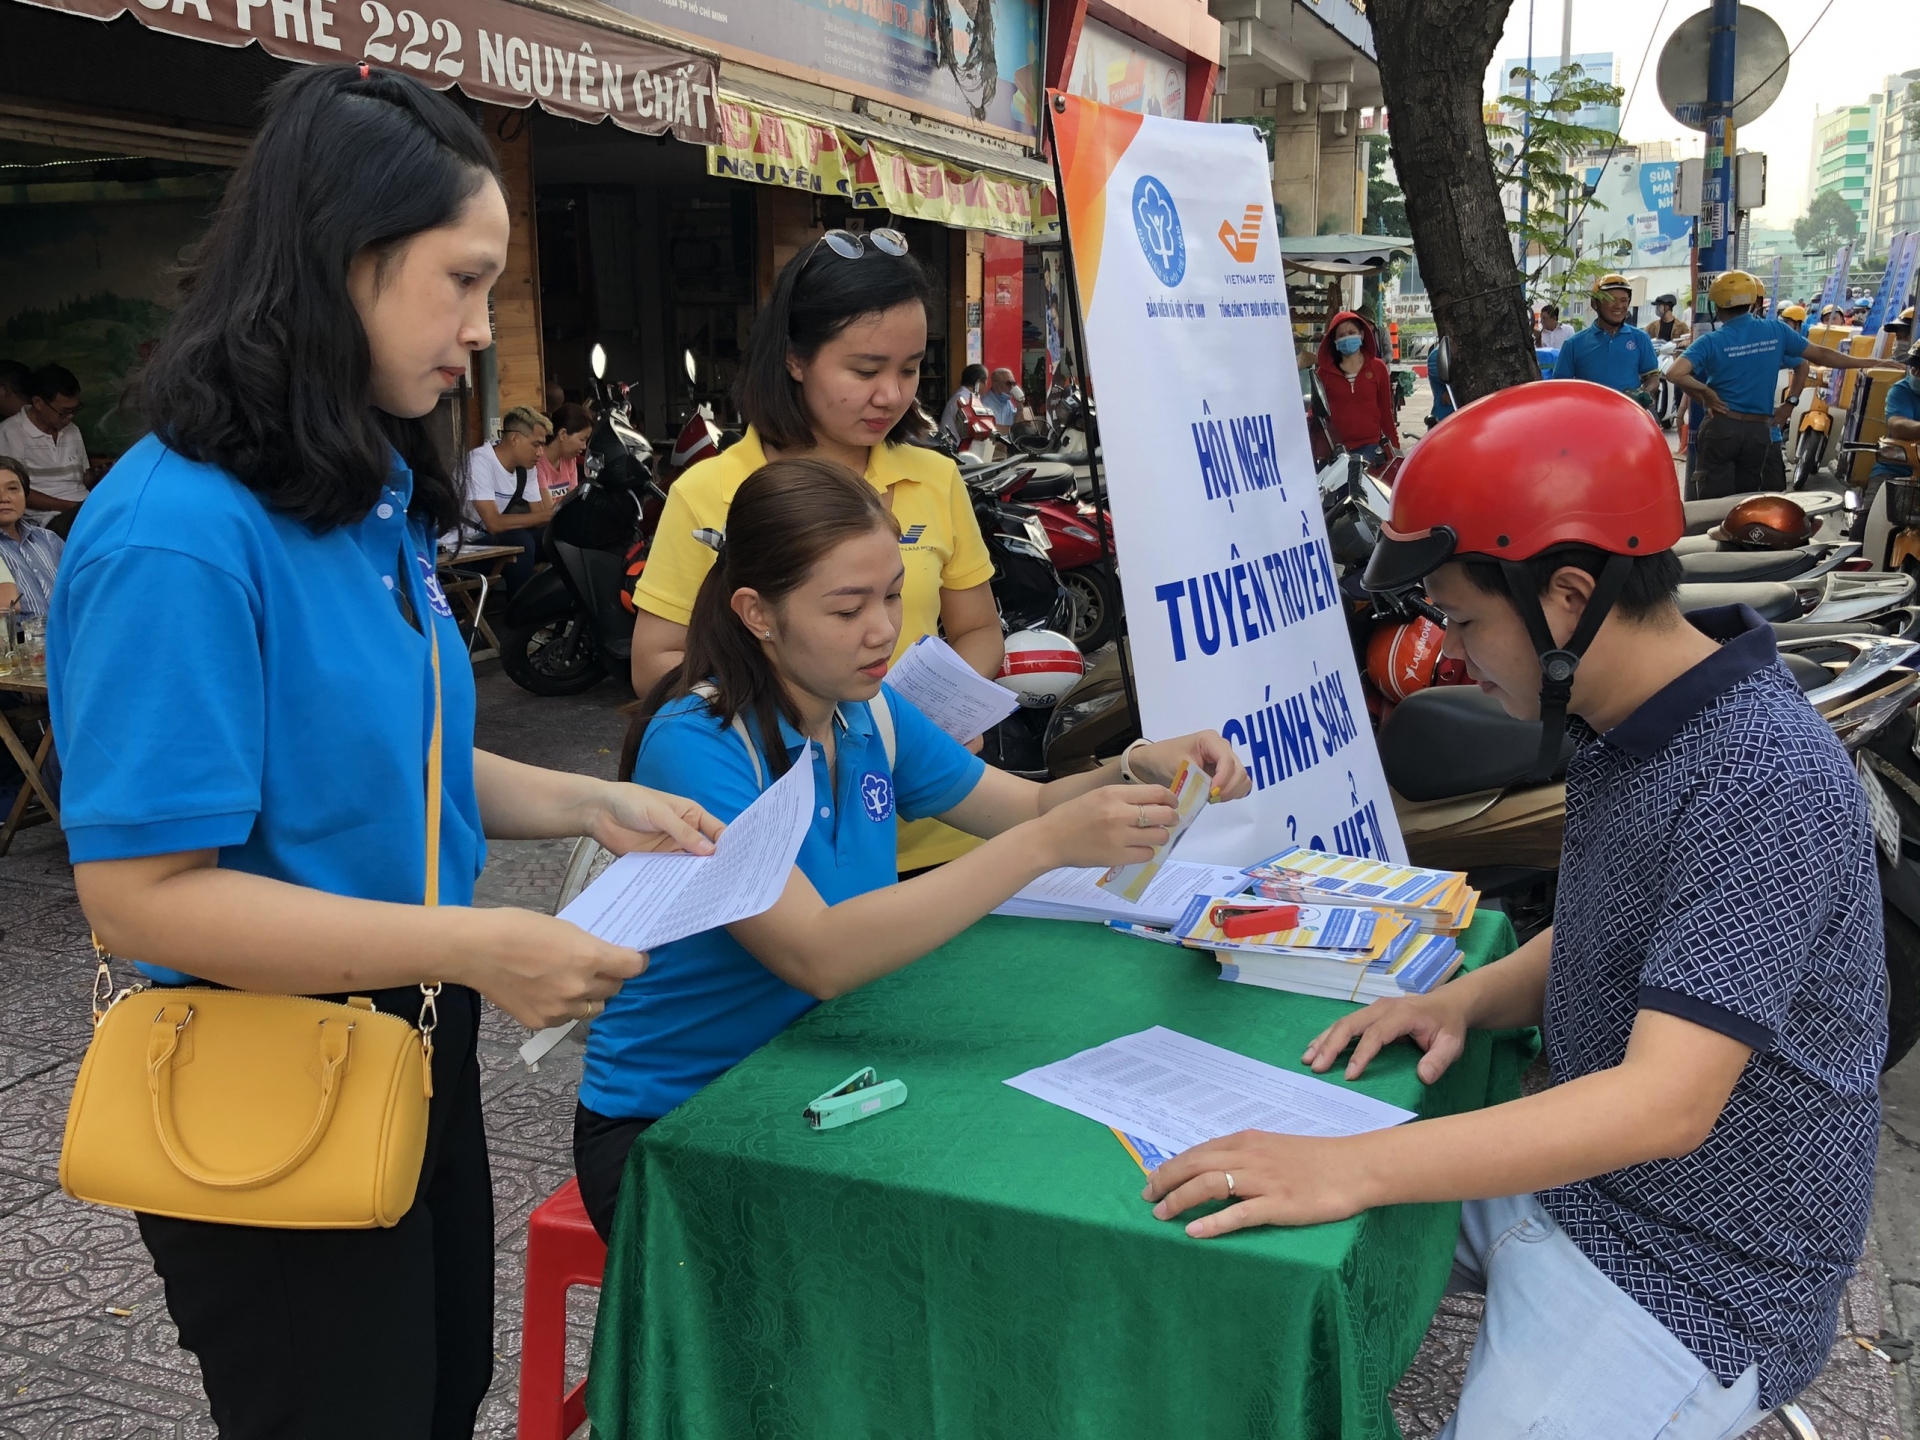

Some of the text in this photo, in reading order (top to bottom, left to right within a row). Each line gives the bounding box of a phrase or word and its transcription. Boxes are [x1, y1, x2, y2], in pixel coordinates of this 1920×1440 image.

[360, 0, 464, 77] 222
[478, 29, 624, 112] NGUYÊN
[633, 64, 711, 129] CHẤT
[1224, 274, 1276, 285] VIETNAM POST
[1191, 399, 1287, 514] HỘI NGHỊ
[1155, 510, 1339, 662] TUYÊN TRUYỀN
[1410, 620, 1433, 670] LALAMOVE
[1221, 660, 1358, 796] CHÍNH SÁCH
